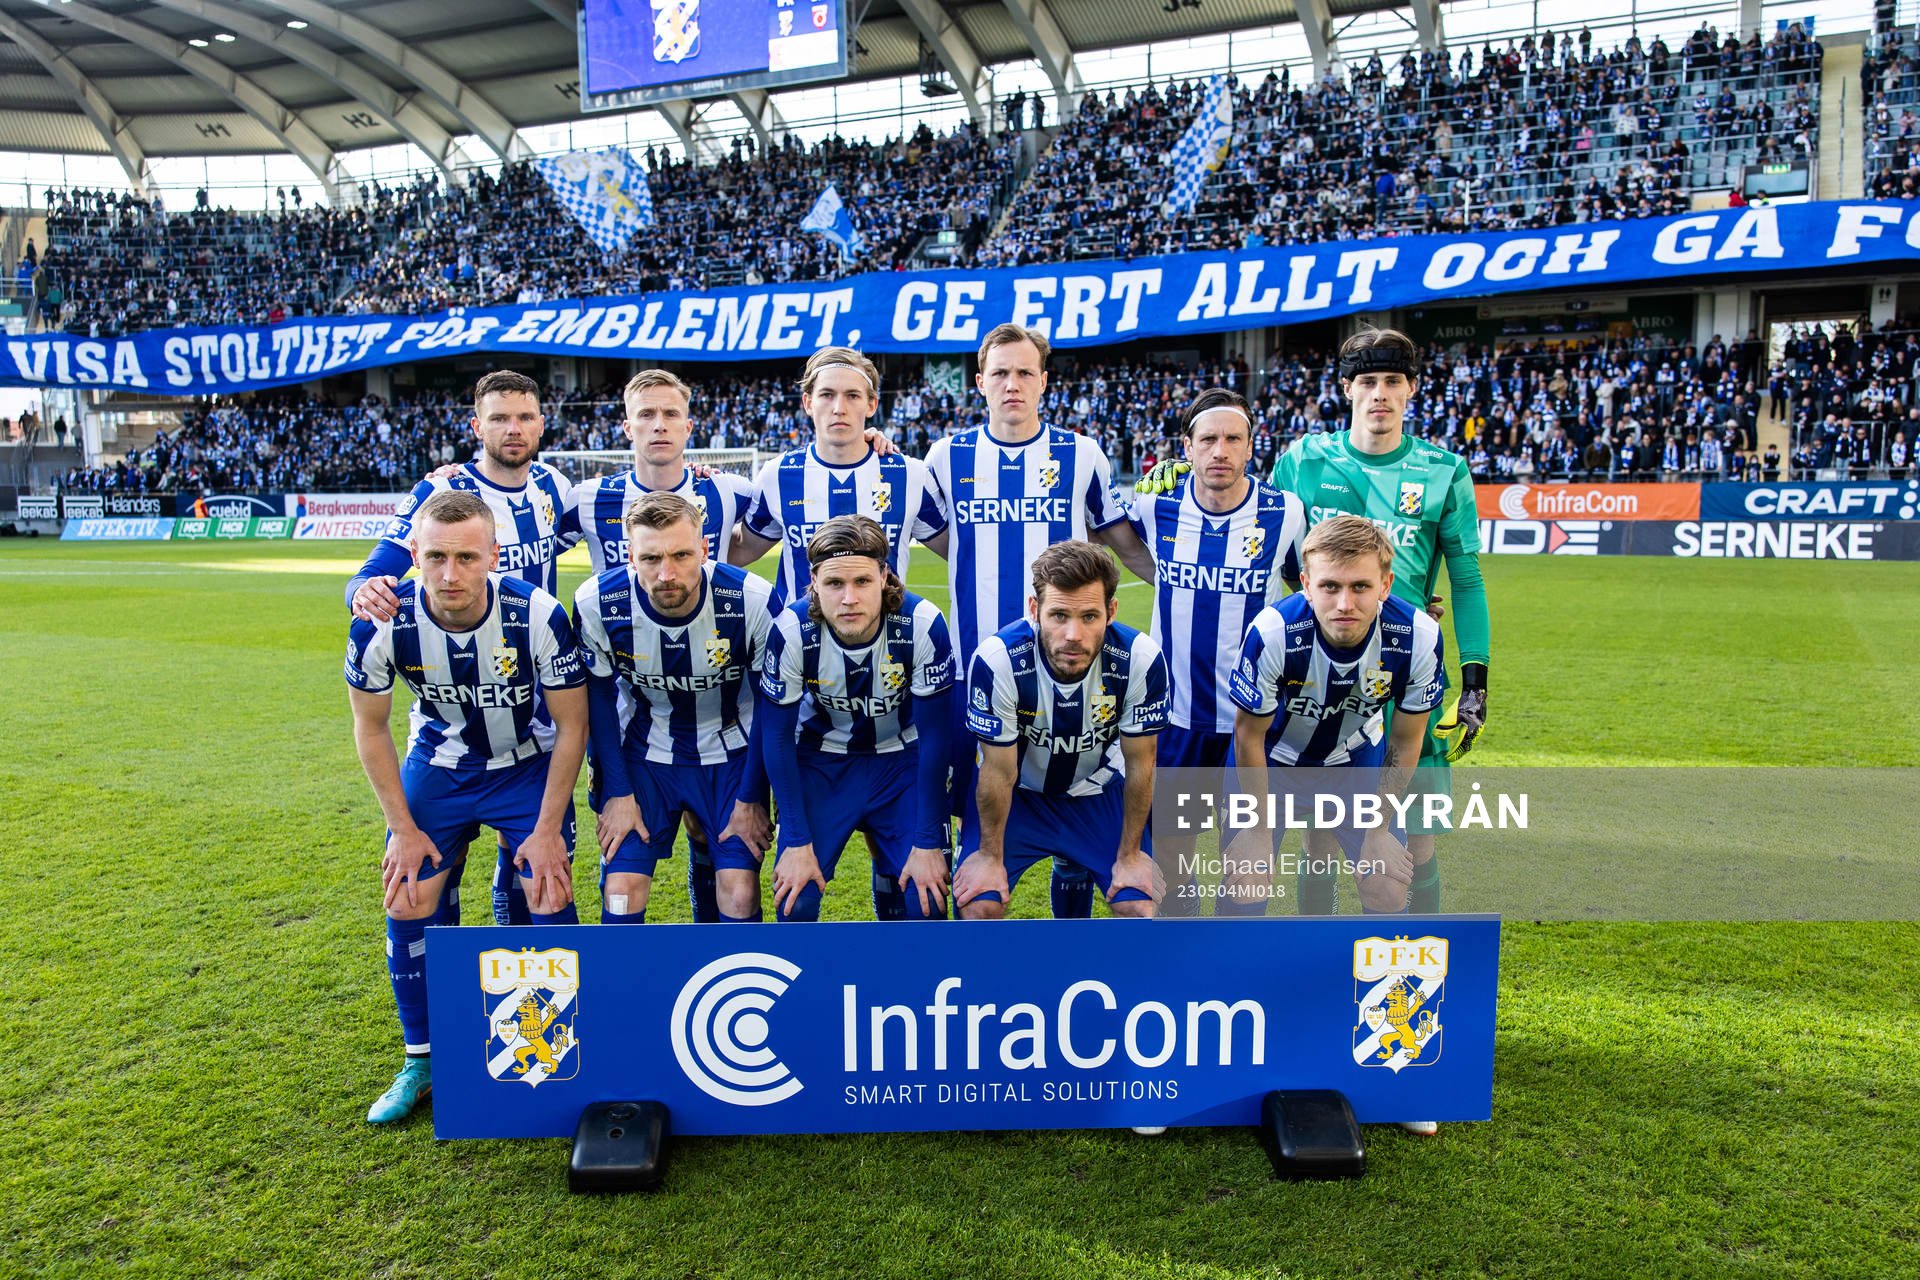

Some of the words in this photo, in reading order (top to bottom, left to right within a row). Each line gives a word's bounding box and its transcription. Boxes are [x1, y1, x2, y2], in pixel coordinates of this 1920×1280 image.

[8, 340, 149, 388] VISA
[164, 322, 391, 386] STOLTHET
[385, 308, 499, 354] FÖR
[891, 281, 986, 342] GE
[1010, 268, 1163, 341] ERT
[1177, 247, 1399, 322] ALLT
[1422, 229, 1621, 291] OCH
[1321, 483, 1344, 492] CRAFT
[105, 496, 160, 513] Helanders
[209, 501, 250, 518] cuebid
[308, 502, 396, 517] Bergkvarabuss
[1537, 490, 1638, 513] InfraCom
[1745, 488, 1898, 515] CRAFT
[956, 498, 1066, 524] SERNEKE
[77, 519, 159, 537] EFFEKTIV
[1672, 521, 1874, 559] SERNEKE
[1159, 559, 1266, 593] SERNEKE
[500, 594, 529, 605] FAMECO
[601, 590, 629, 601] FAMECO
[714, 588, 743, 597] FAMECO
[1286, 620, 1314, 631] FAMECO
[1381, 623, 1412, 633] FAMECO
[1008, 642, 1034, 656] FAMECO
[1103, 643, 1130, 659] FAMECO
[1232, 673, 1261, 701] UNIBET
[843, 977, 1266, 1073] InfraCom
[844, 1085, 929, 1105] SMART
[938, 1082, 1032, 1104] DIGITAL
[1042, 1079, 1179, 1102] SOLUTIONS
